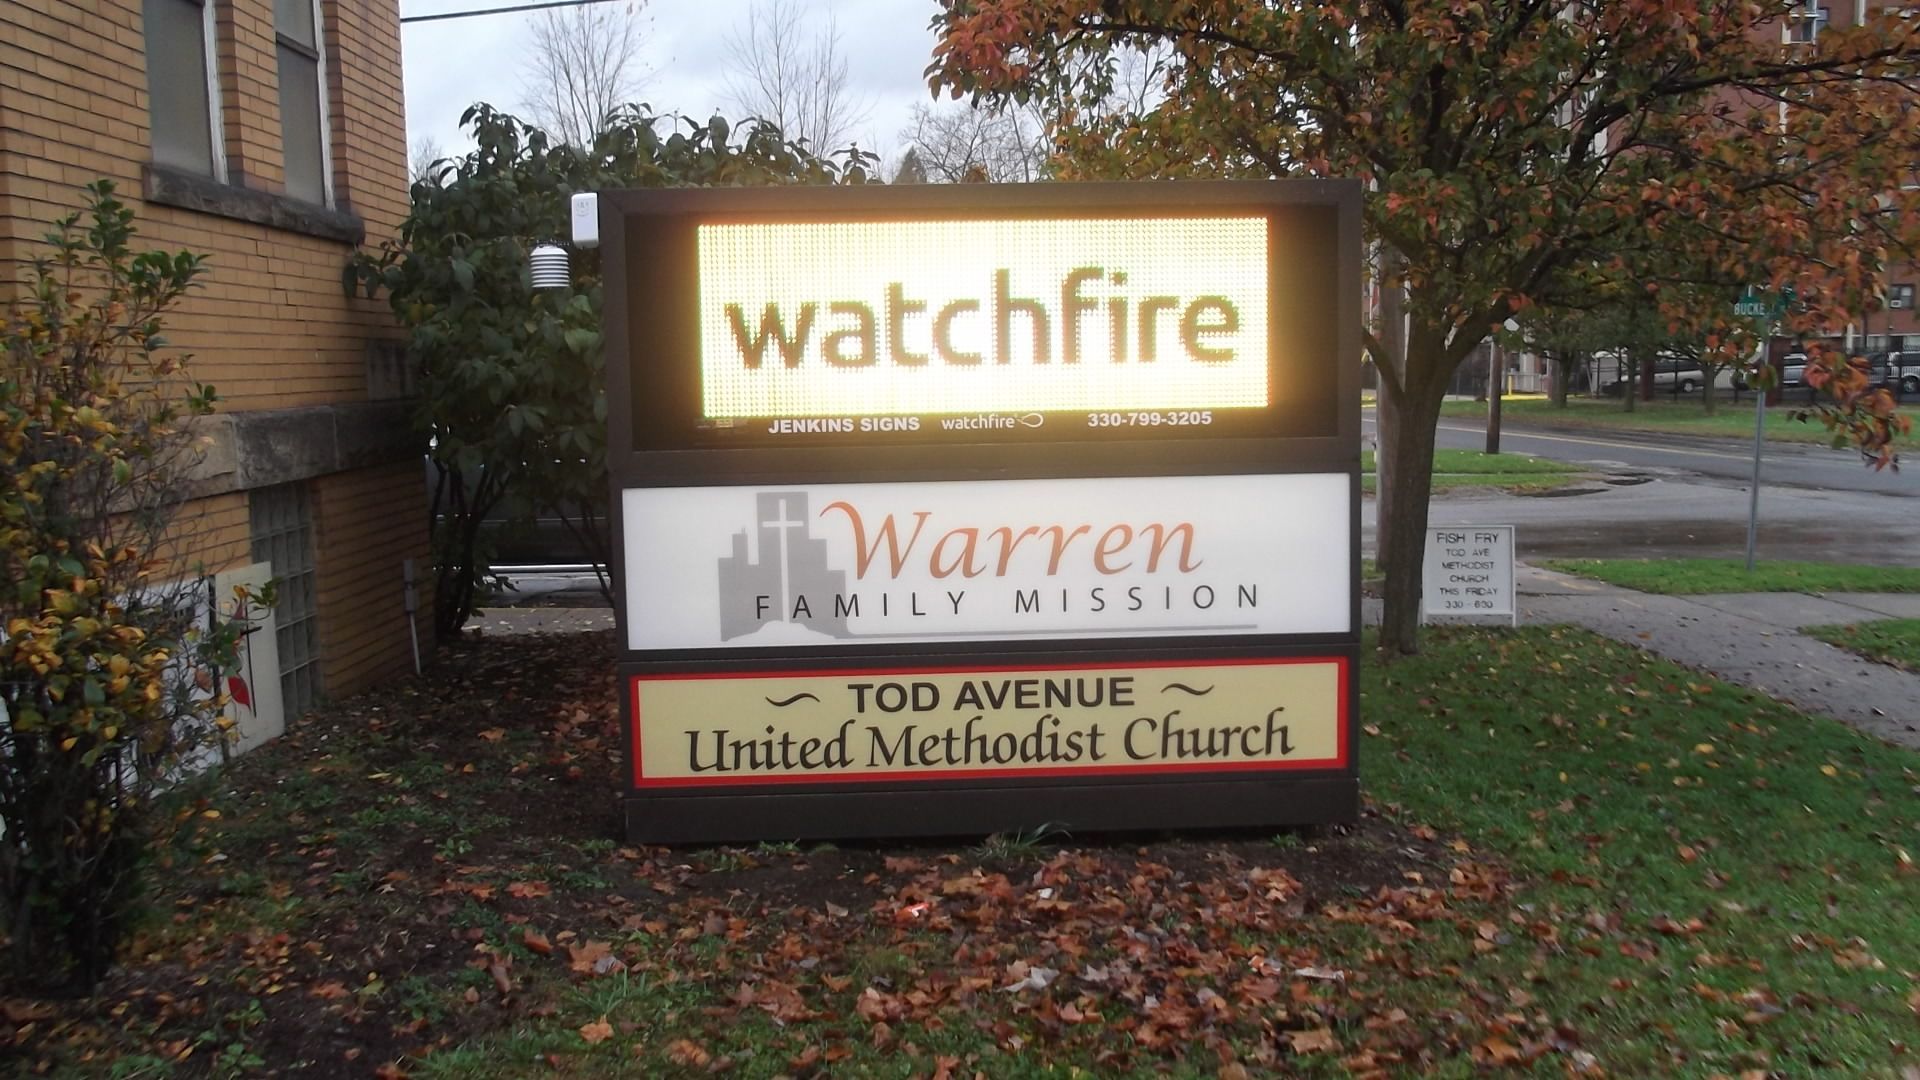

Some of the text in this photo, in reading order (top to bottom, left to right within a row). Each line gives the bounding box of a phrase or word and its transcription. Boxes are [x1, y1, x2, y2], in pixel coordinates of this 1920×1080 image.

[1734, 302, 1776, 315] BUCKE
[725, 265, 1240, 370] watchfire
[768, 416, 920, 434] JENKINS SIGNS
[941, 413, 1015, 430] watchfire
[1087, 411, 1212, 427] 330-799-3205
[819, 501, 1203, 582] Warren
[1436, 532, 1499, 544] FISH FRY
[1472, 548, 1490, 557] AVE
[1441, 561, 1495, 570] METHODIST
[1449, 574, 1489, 583] CHURCH
[1439, 587, 1498, 596] THIS FRIDAY
[755, 583, 1259, 619] FAMILY MISSION
[847, 676, 1135, 713] TOD AVENUE
[684, 707, 1295, 772] United Methodist Church
